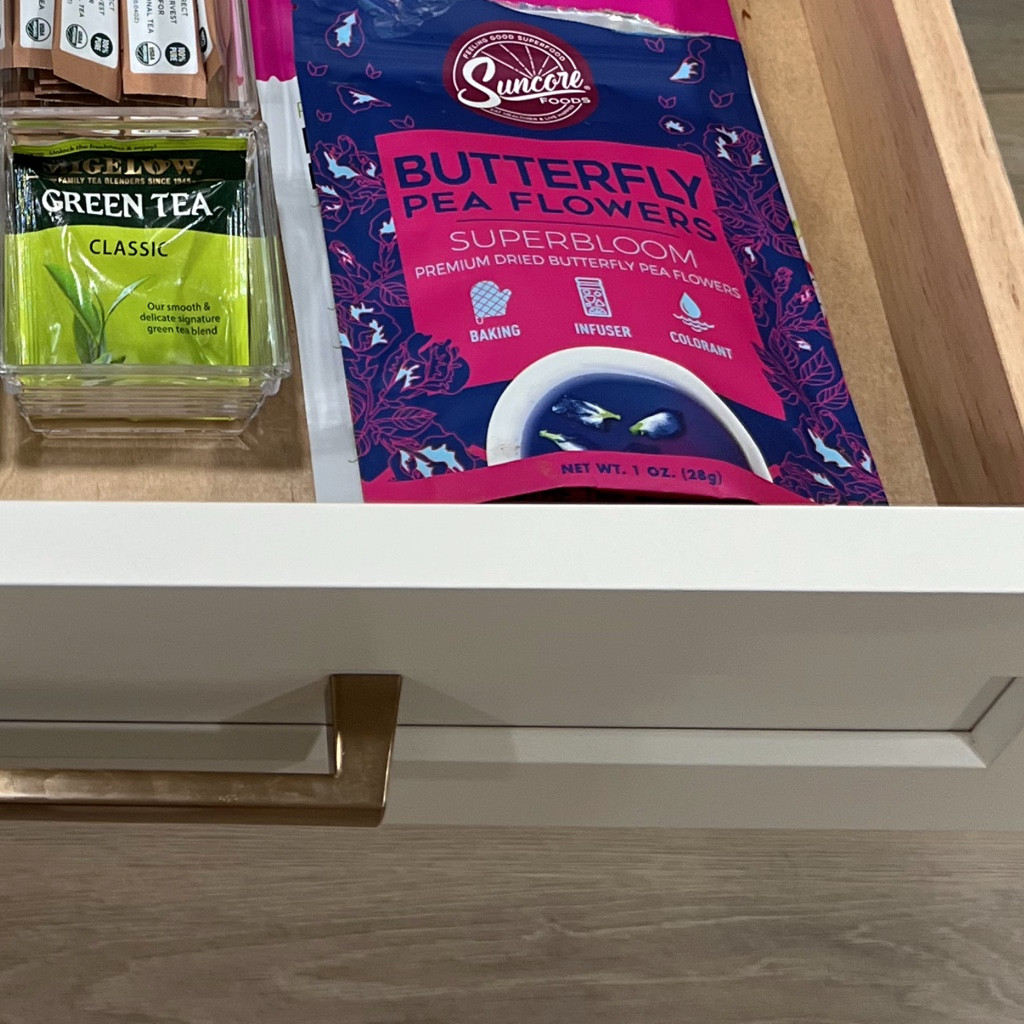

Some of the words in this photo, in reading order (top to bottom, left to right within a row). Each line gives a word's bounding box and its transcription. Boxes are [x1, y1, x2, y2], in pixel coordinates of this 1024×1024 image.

[463, 38, 488, 59] FEELING
[517, 35, 566, 62] SUPERFOOD
[458, 56, 584, 108] Suncore
[58, 177, 84, 185] FAMILY
[147, 177, 171, 185] SINCE
[394, 151, 702, 210] BUTTERFLY
[42, 188, 143, 219] GREEN
[150, 192, 214, 218] TEA
[403, 190, 494, 219] PEA
[508, 191, 718, 243] FLOWERS
[89, 239, 169, 257] CLASSIC
[449, 229, 698, 269] SUPERBLOOM
[415, 256, 491, 279] PREMIUM
[495, 254, 544, 266] DRIED
[550, 255, 635, 272] BUTTERFLY
[640, 263, 672, 279] PEA
[673, 269, 741, 300] FLOWERS
[469, 324, 521, 343] BAKING
[574, 322, 632, 338] INFUSER
[669, 331, 733, 360] COLORANT
[561, 463, 590, 474] NET
[596, 463, 627, 475] WT.
[632, 465, 639, 475] 1
[647, 466, 676, 478] OZ.
[682, 468, 723, 486] (28g)
